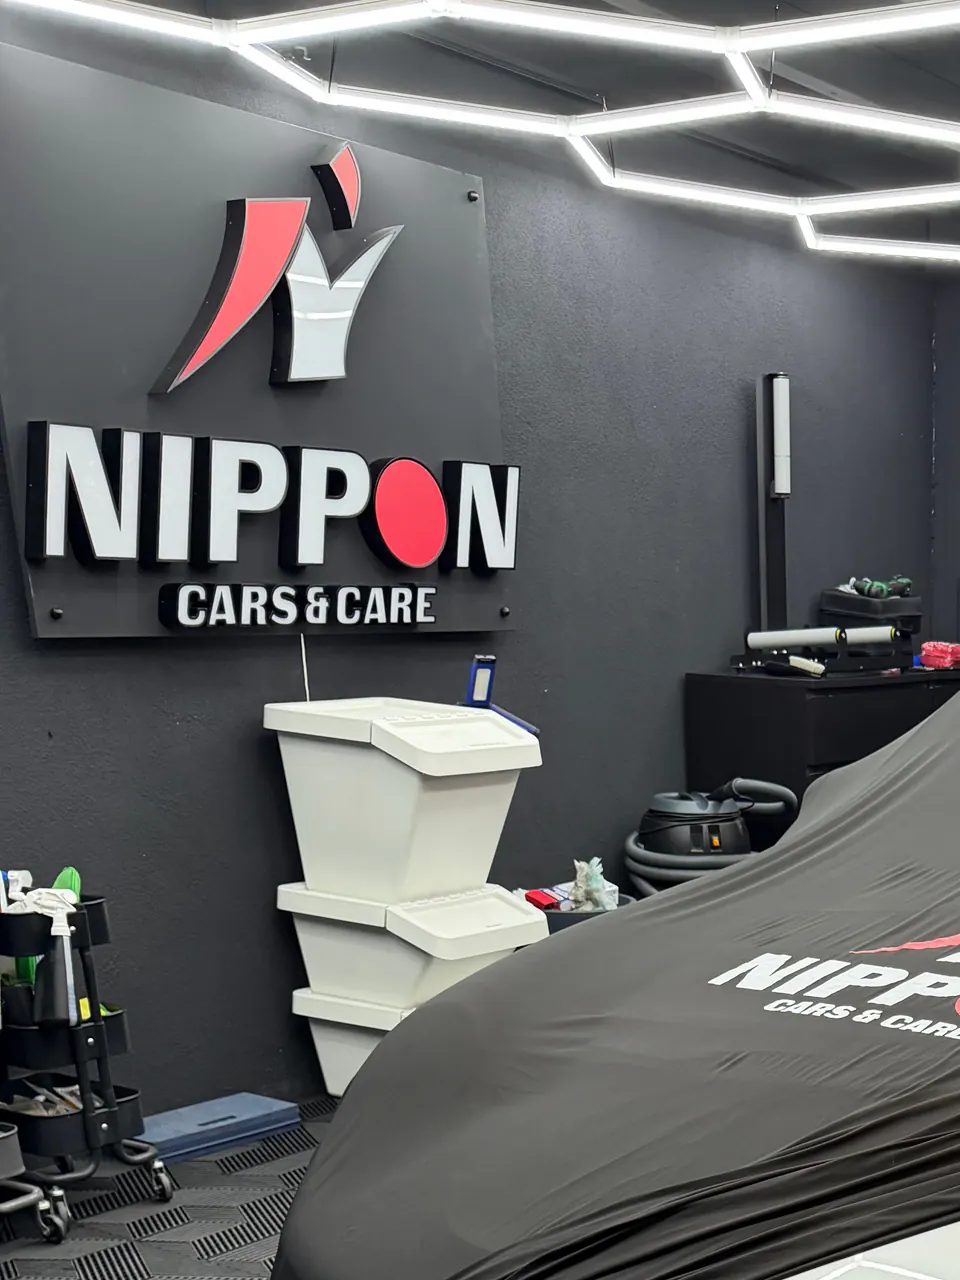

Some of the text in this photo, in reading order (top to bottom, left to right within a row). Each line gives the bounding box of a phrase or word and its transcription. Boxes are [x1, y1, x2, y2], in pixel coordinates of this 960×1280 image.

[45, 422, 520, 570] NIPPON
[763, 999, 856, 1019] CARS
[852, 1009, 883, 1024] &
